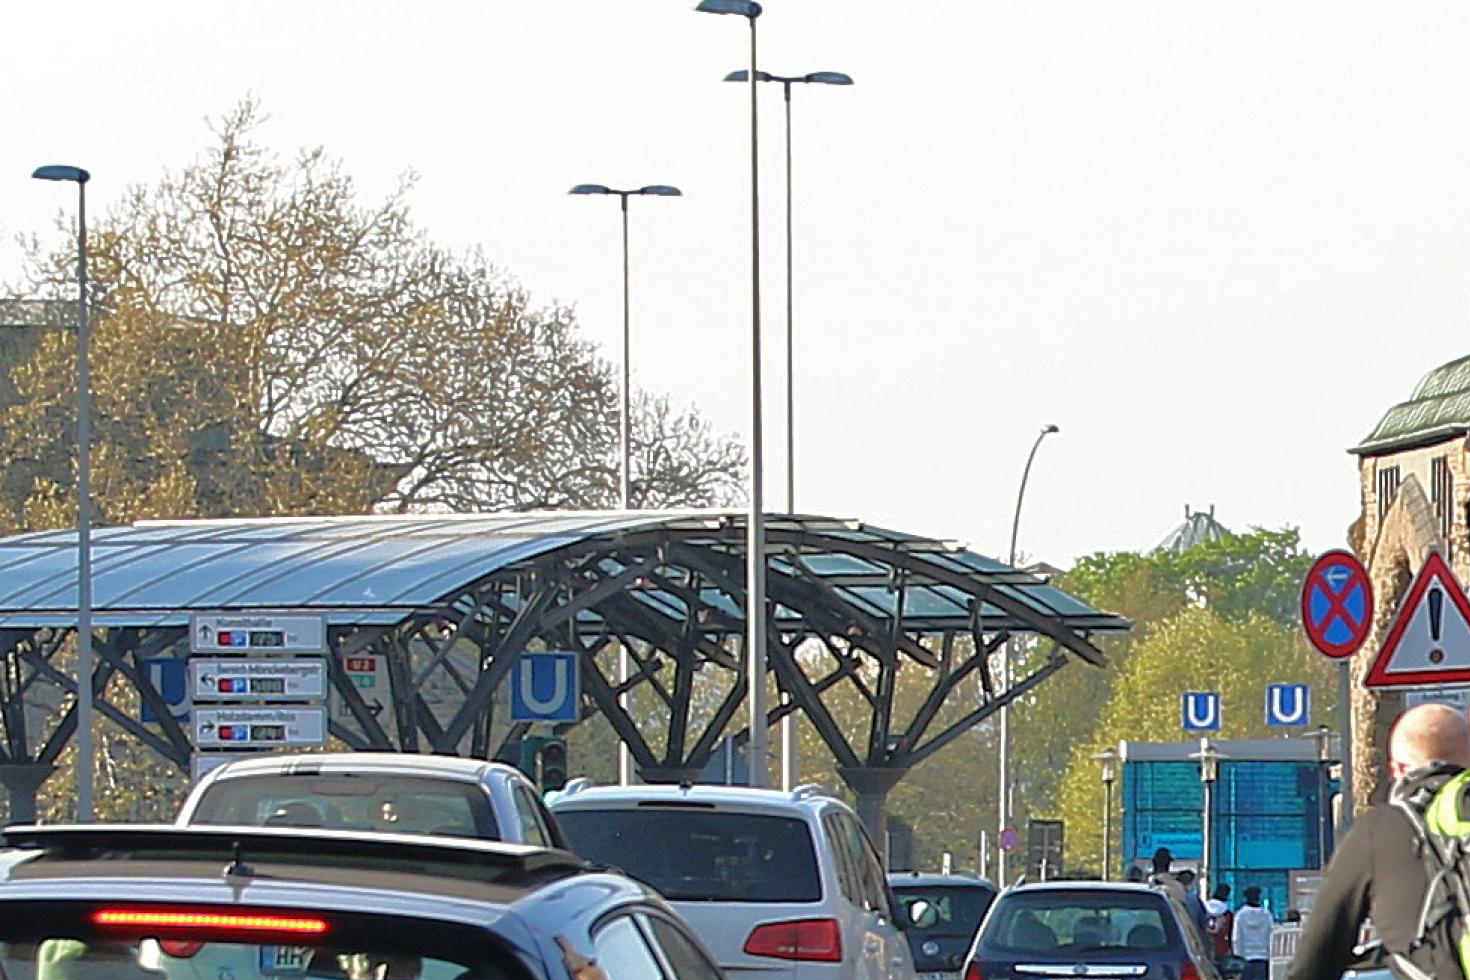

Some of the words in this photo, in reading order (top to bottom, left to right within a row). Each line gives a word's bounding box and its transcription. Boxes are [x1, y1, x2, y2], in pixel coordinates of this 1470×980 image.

[521, 659, 567, 715] U
[1273, 686, 1304, 723] U
[1188, 695, 1215, 727] U
